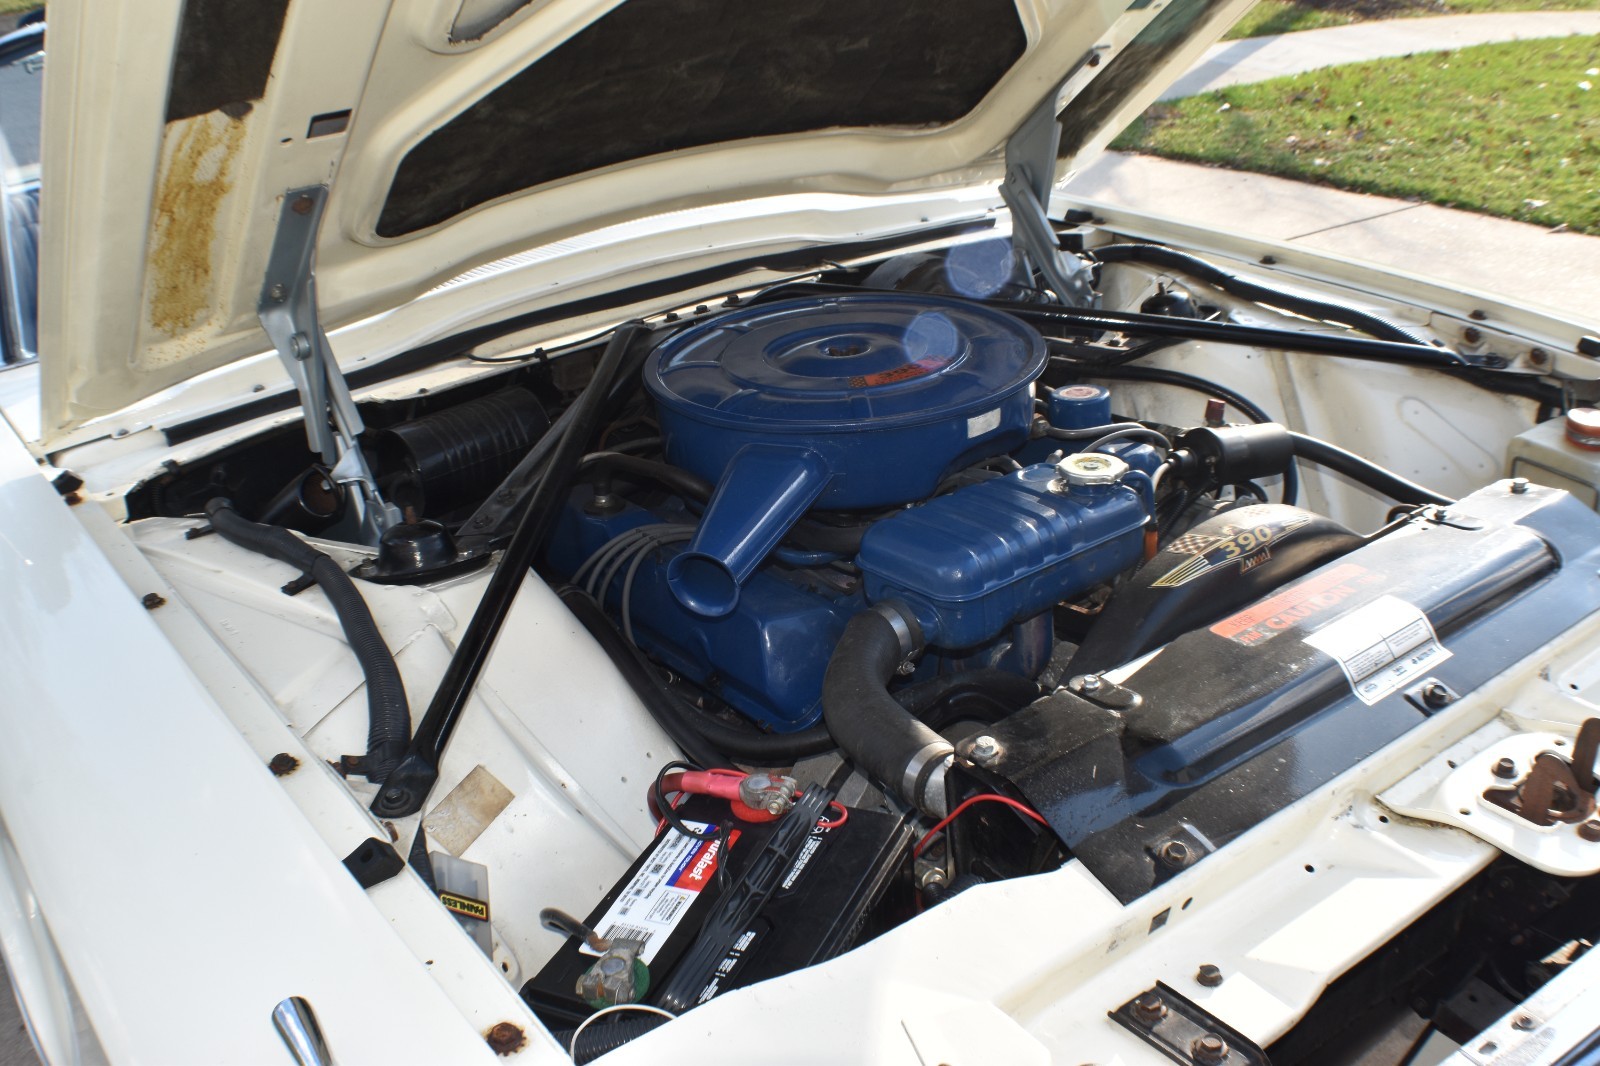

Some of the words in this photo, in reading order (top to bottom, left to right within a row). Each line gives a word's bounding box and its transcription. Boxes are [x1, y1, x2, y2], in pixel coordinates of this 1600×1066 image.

[1219, 524, 1274, 559] 390
[688, 837, 722, 881] uralast
[440, 895, 485, 917] PAINLESS
